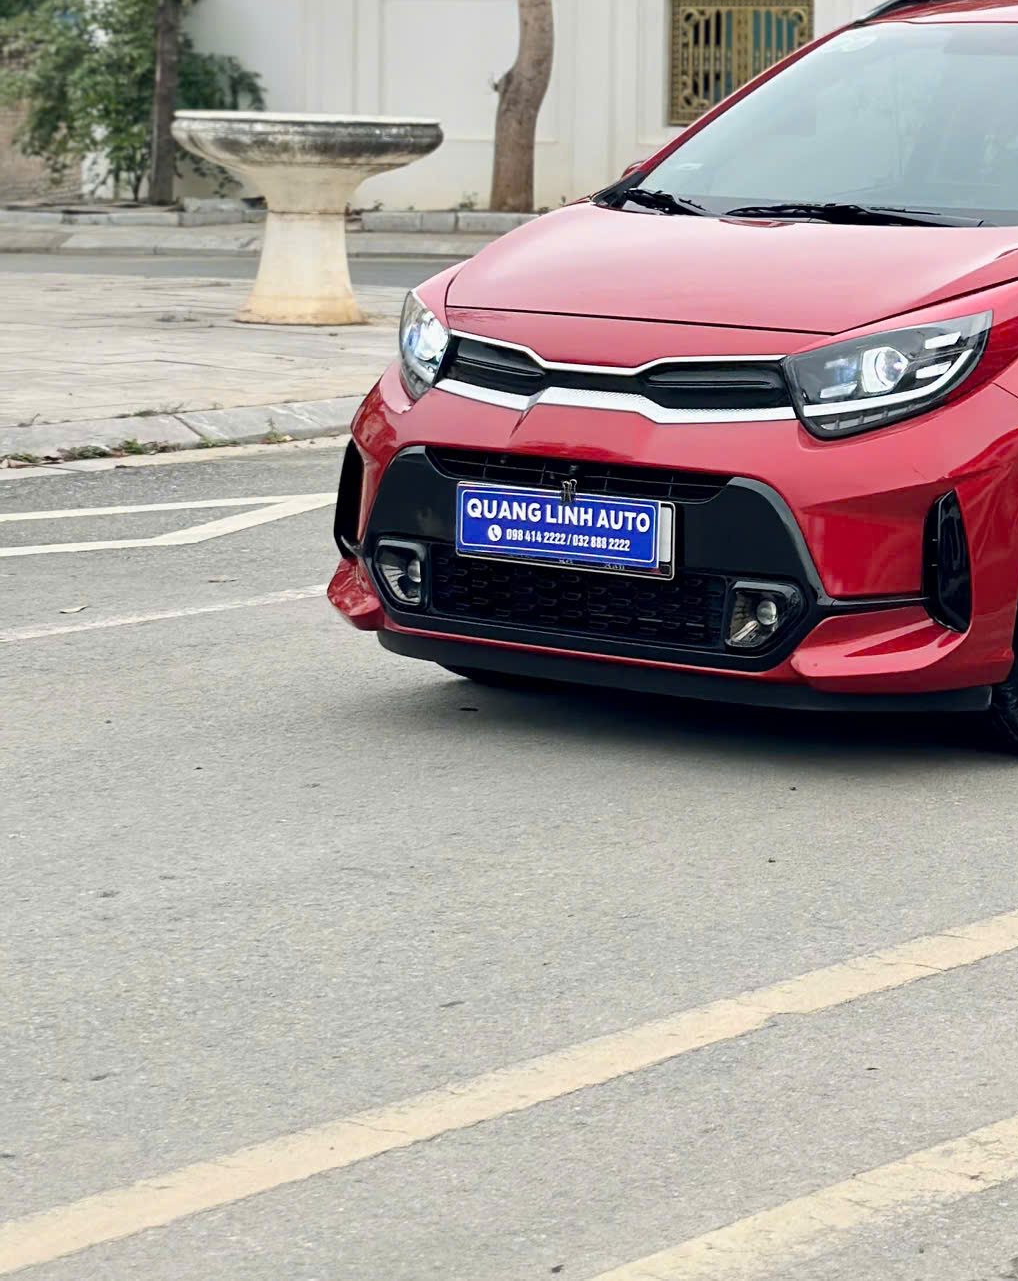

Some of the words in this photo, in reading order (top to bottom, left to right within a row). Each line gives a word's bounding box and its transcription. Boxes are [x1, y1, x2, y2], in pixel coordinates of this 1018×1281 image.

[467, 498, 541, 522] QUANG
[545, 504, 593, 527] LINH
[597, 509, 650, 533] AUTO
[506, 528, 524, 541] 098
[525, 530, 542, 543] 414
[543, 532, 566, 545] 2222
[572, 534, 589, 547] 032
[608, 538, 631, 552] 2222
